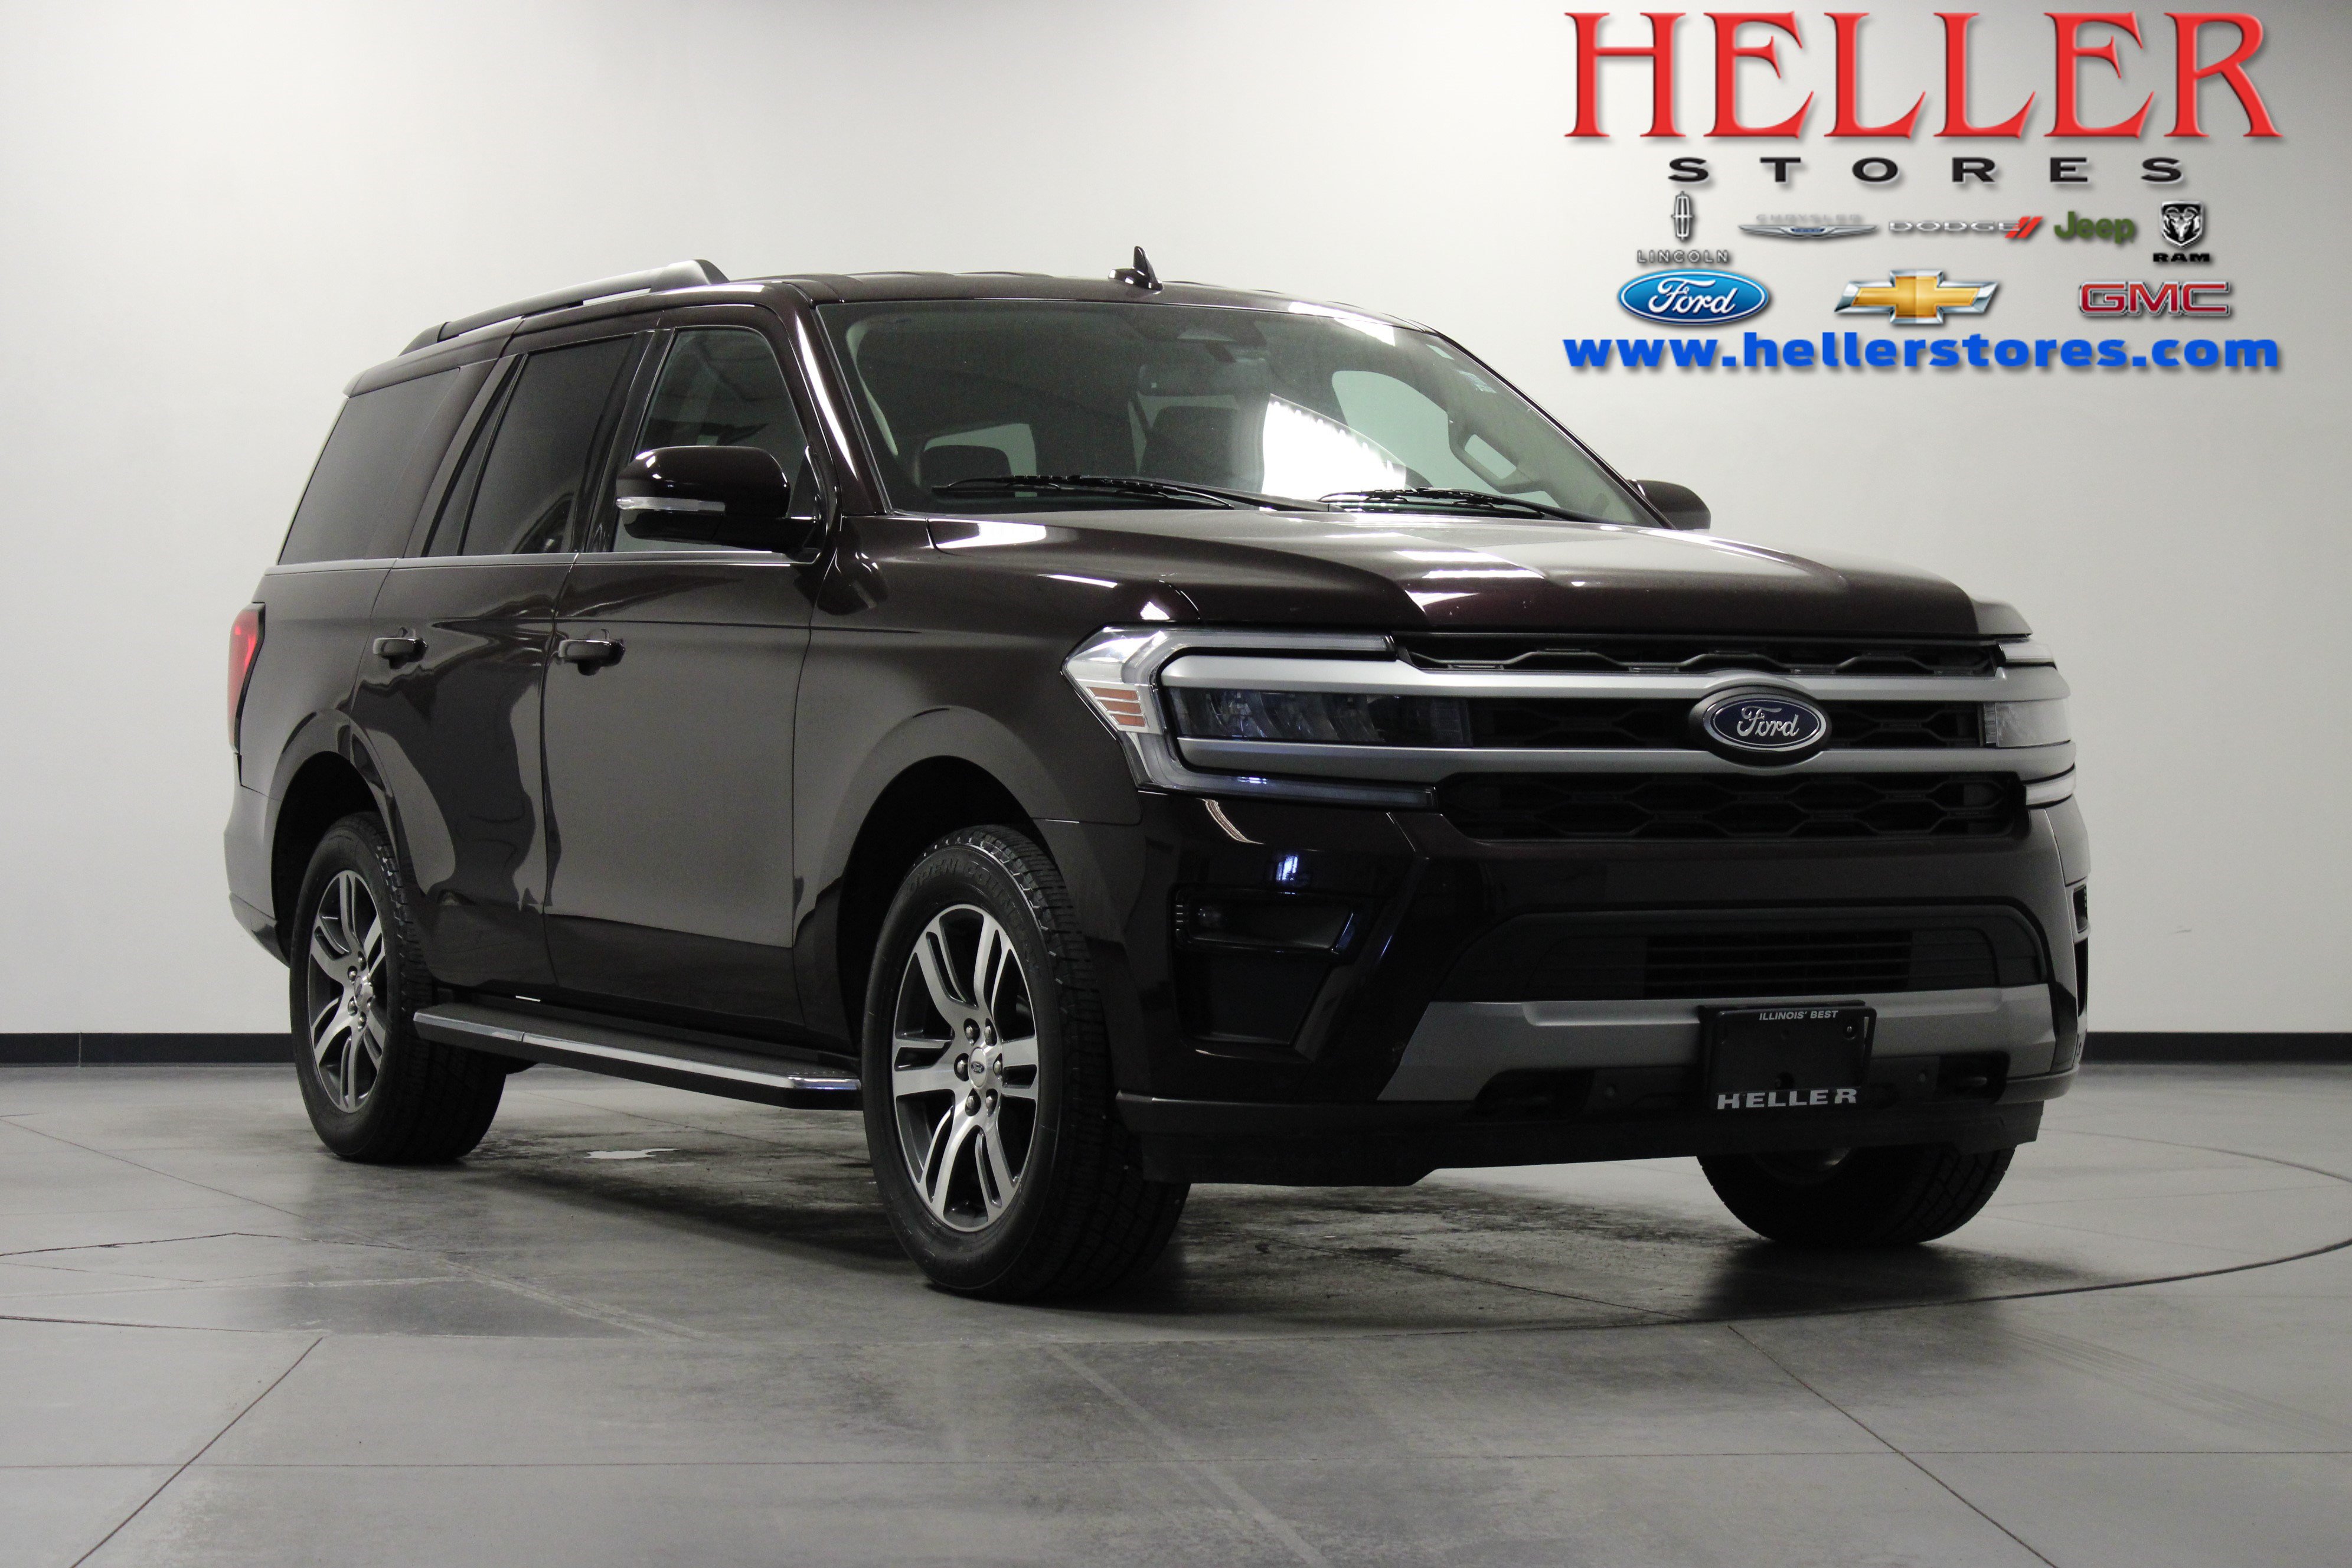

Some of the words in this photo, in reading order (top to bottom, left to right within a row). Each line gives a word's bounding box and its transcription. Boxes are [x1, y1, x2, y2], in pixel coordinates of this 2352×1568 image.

[1736, 705, 1799, 737] Ford
[1809, 1010, 1839, 1019] BEST
[1717, 1088, 1858, 1110] HELLER
